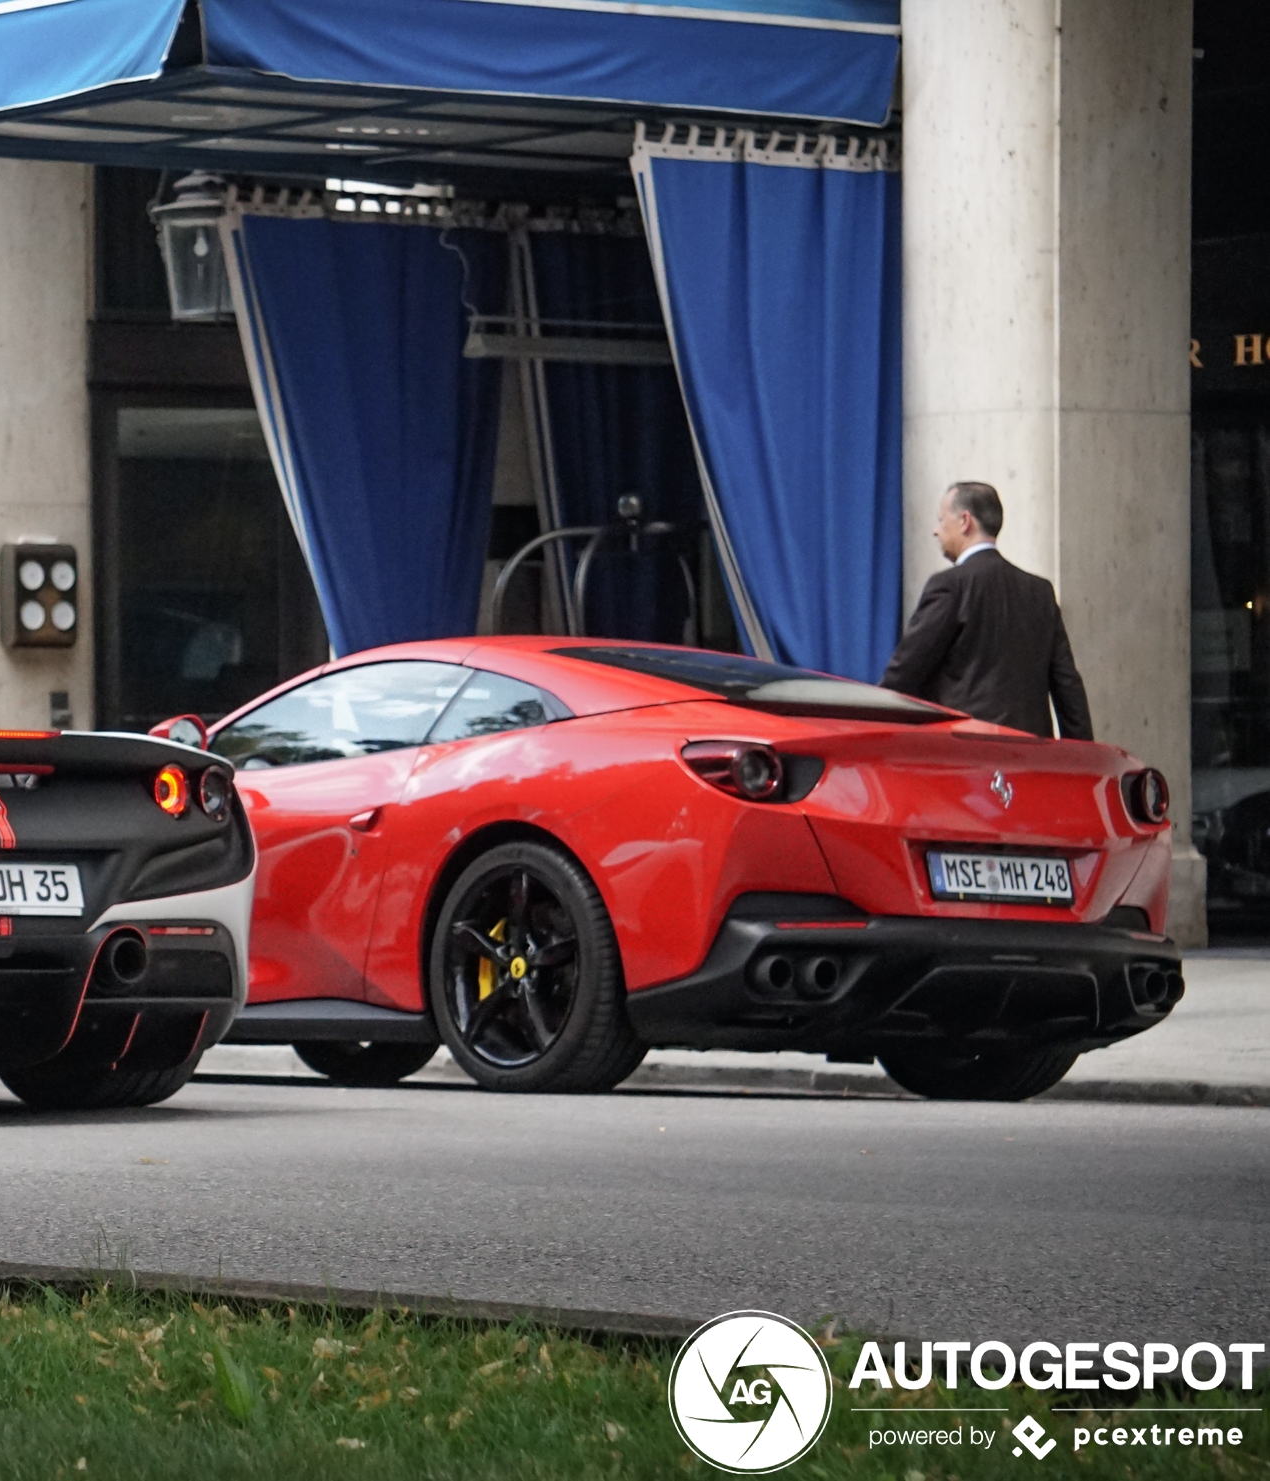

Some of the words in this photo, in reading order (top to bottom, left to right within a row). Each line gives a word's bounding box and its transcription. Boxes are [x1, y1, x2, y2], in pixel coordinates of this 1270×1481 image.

[1234, 334, 1270, 366] H
[34, 870, 69, 902] 35
[944, 859, 986, 888] MSE
[999, 862, 1028, 890] MH
[1031, 864, 1068, 892] 248
